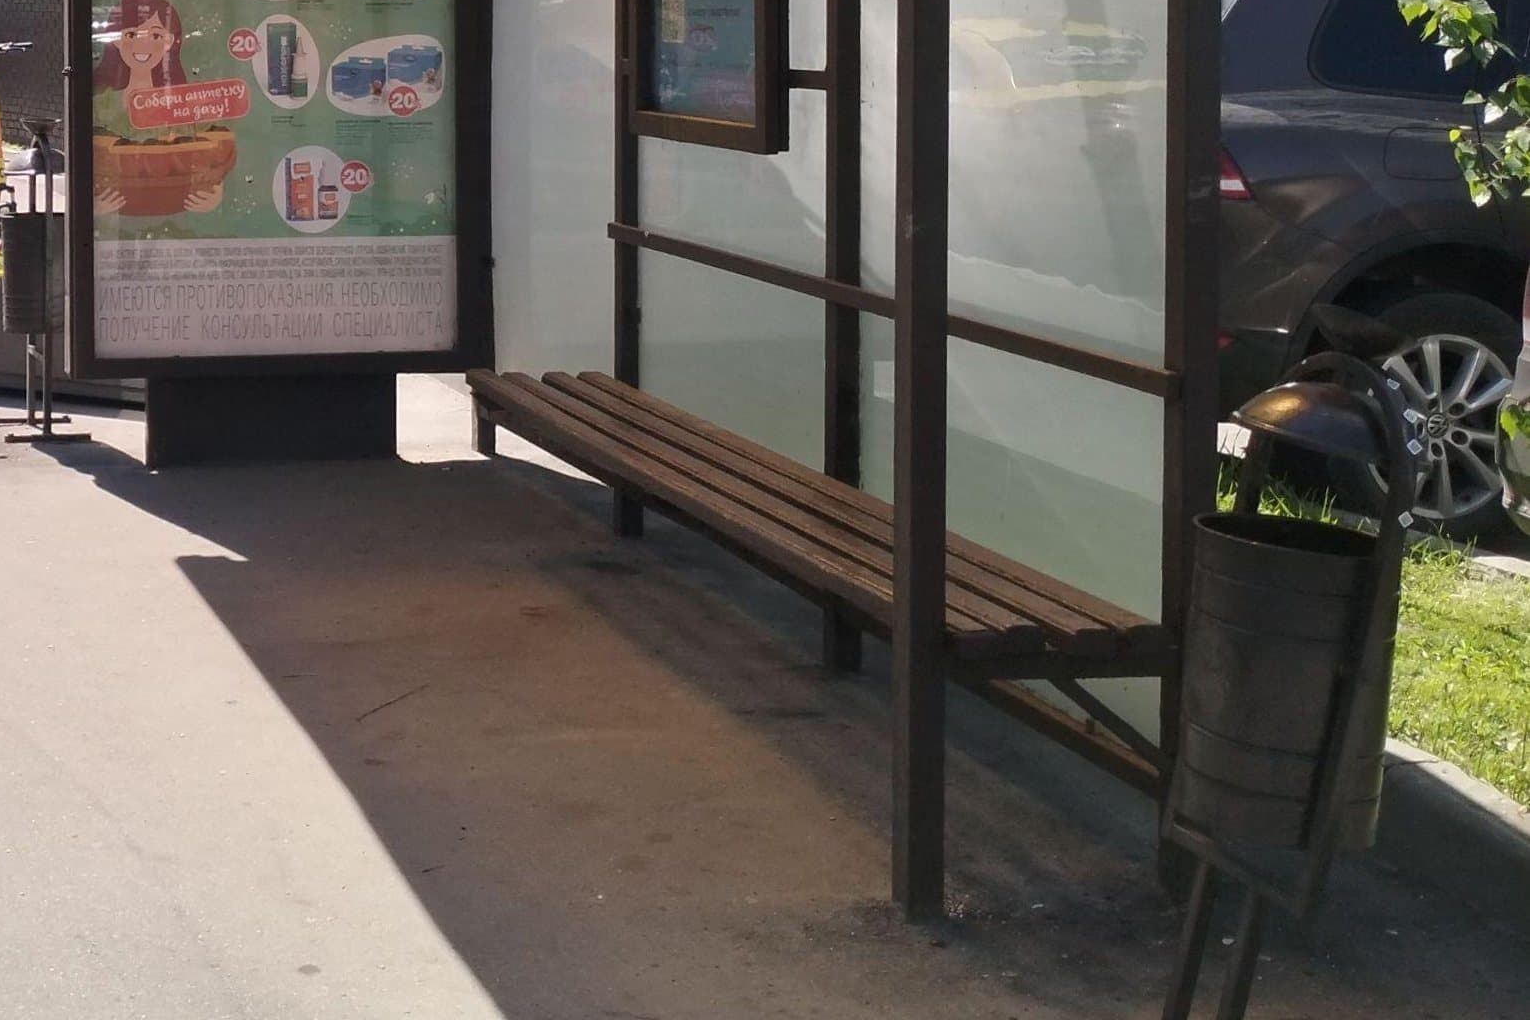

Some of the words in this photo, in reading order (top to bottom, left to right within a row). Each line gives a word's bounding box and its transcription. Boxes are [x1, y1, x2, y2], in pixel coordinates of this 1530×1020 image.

[134, 93, 183, 109] Собери
[185, 85, 245, 100] аптечку
[173, 108, 190, 117] на
[193, 99, 230, 120] дачу!
[99, 284, 170, 312] ИМЕЮТСЯ
[342, 282, 442, 308] НЕОБХОДИМО
[99, 315, 191, 342] ПОЛУЧЕНИЕ
[201, 314, 323, 341] КОНСУЛЬТАЦИИ
[333, 311, 443, 338] СПЕЦИАЛИСТА
